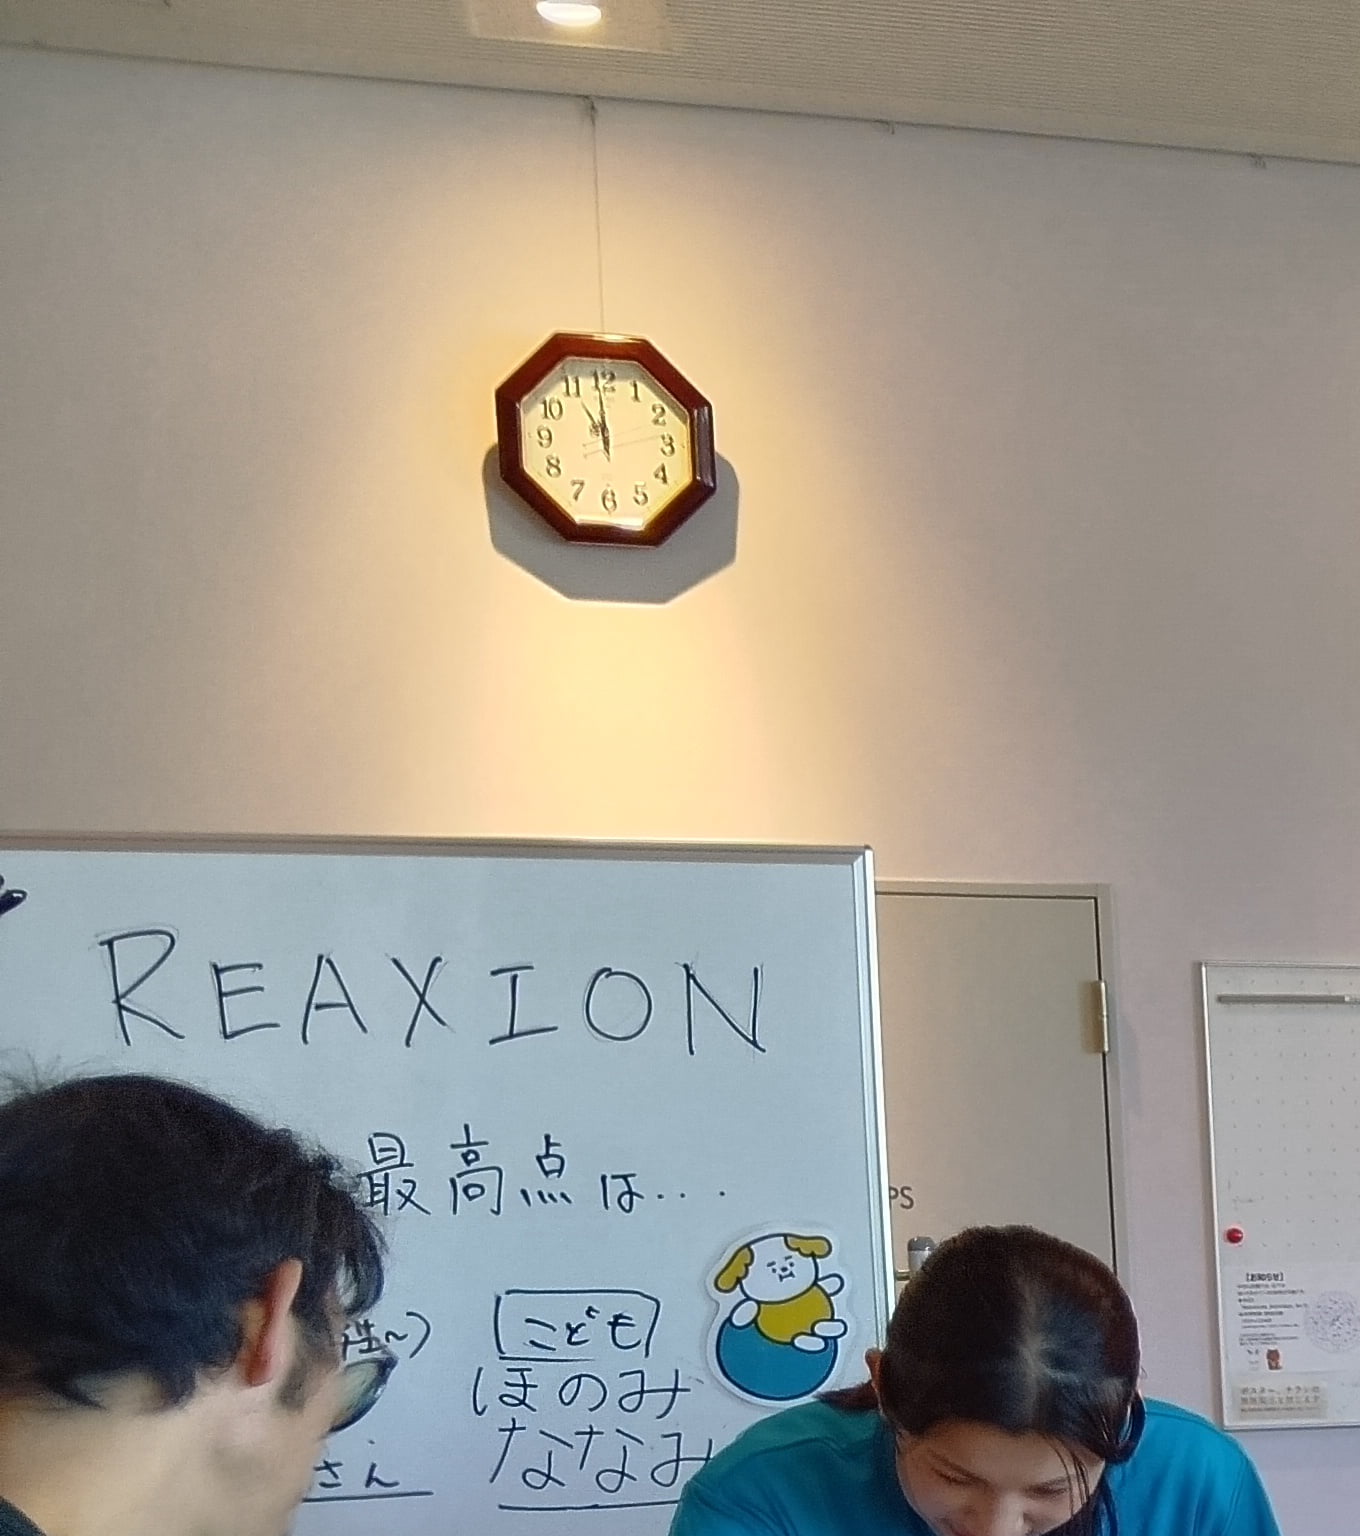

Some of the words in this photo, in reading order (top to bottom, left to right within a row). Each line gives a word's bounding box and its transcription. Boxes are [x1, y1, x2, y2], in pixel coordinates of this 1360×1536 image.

[564, 375, 581, 398] 11
[592, 370, 616, 393] 12
[630, 380, 641, 402] 1
[540, 398, 563, 421] 10
[651, 403, 667, 426] 2
[536, 426, 552, 448] 9
[660, 433, 676, 456] 3
[545, 455, 562, 478] 8
[654, 463, 669, 485] 4
[570, 480, 585, 501] 7
[601, 488, 618, 512] 6
[633, 482, 649, 506] 5
[98, 927, 768, 1054] REAXION
[525, 1306, 641, 1350] こども
[472, 1366, 691, 1419] ほのみ
[490, 1418, 712, 1492] ななみ
